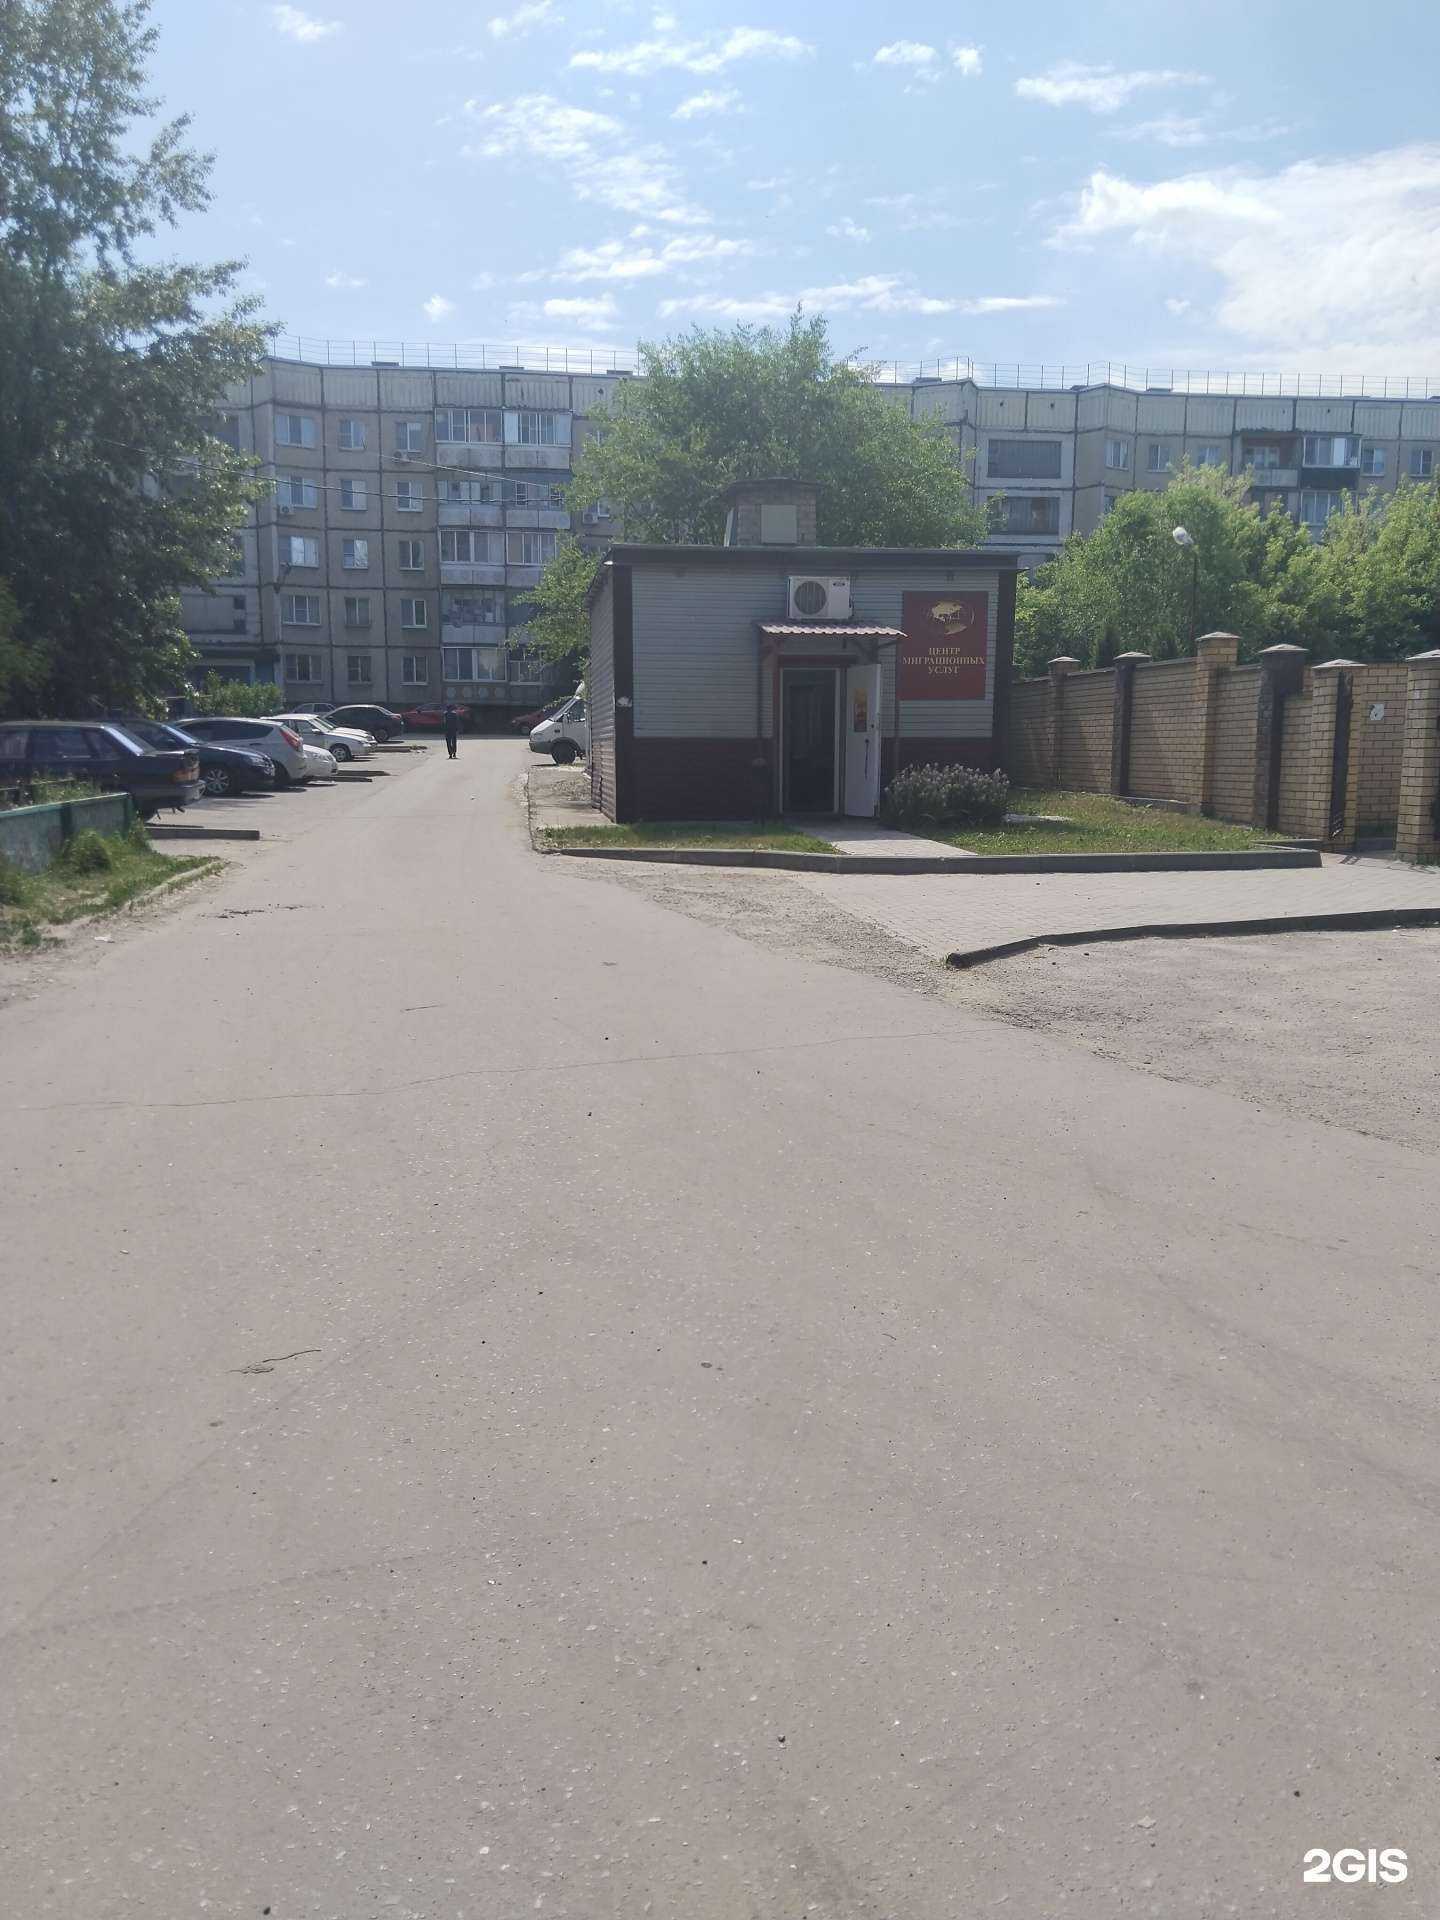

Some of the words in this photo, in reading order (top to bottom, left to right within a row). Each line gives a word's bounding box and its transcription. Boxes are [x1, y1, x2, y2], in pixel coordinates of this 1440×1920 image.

[928, 647, 961, 656] ЦЕНТР
[902, 656, 985, 665] МИГРАЦИОННЫХ
[928, 665, 960, 674] УСЛУГ
